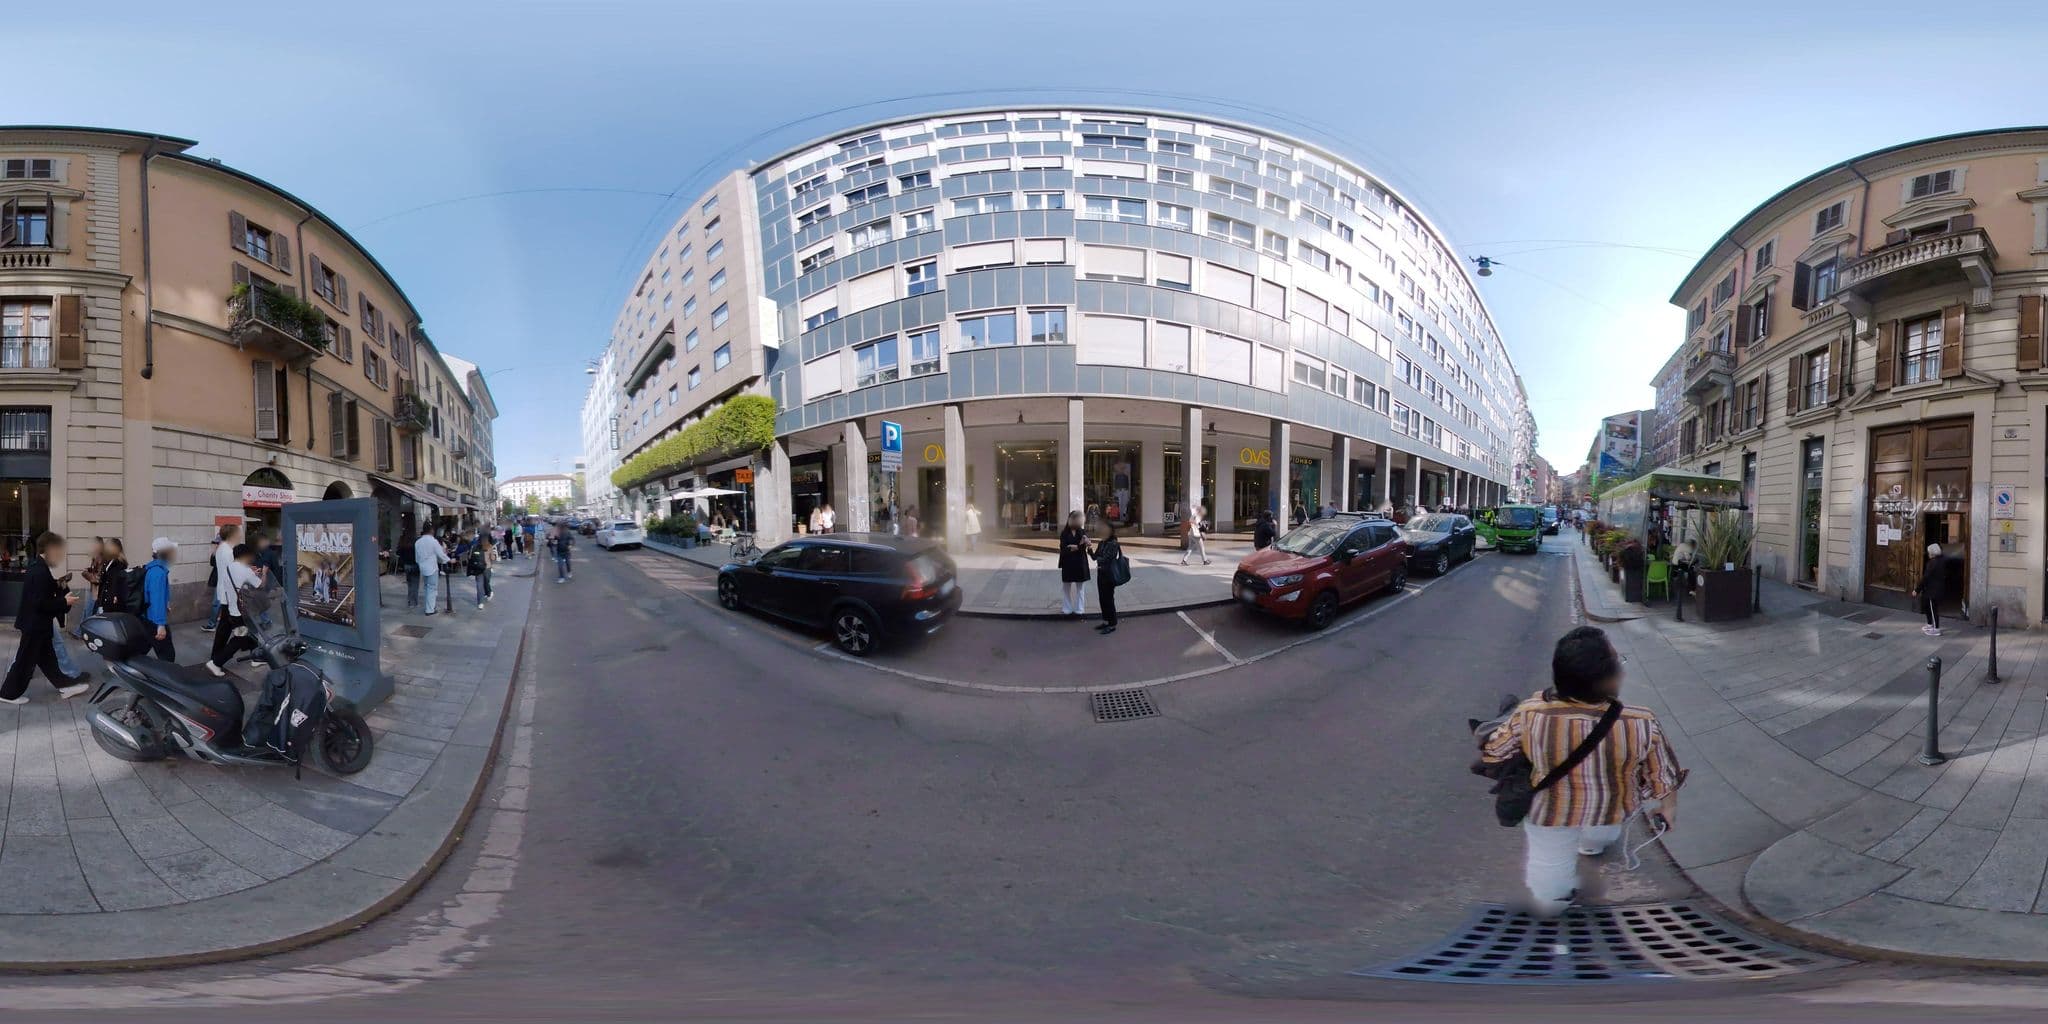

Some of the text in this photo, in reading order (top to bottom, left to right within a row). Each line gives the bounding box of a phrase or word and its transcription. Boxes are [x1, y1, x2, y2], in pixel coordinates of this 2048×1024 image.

[885, 424, 898, 448] P
[924, 444, 945, 463] OV
[1240, 447, 1271, 465] OVS
[257, 490, 278, 500] Charity
[297, 532, 352, 547] MILANO
